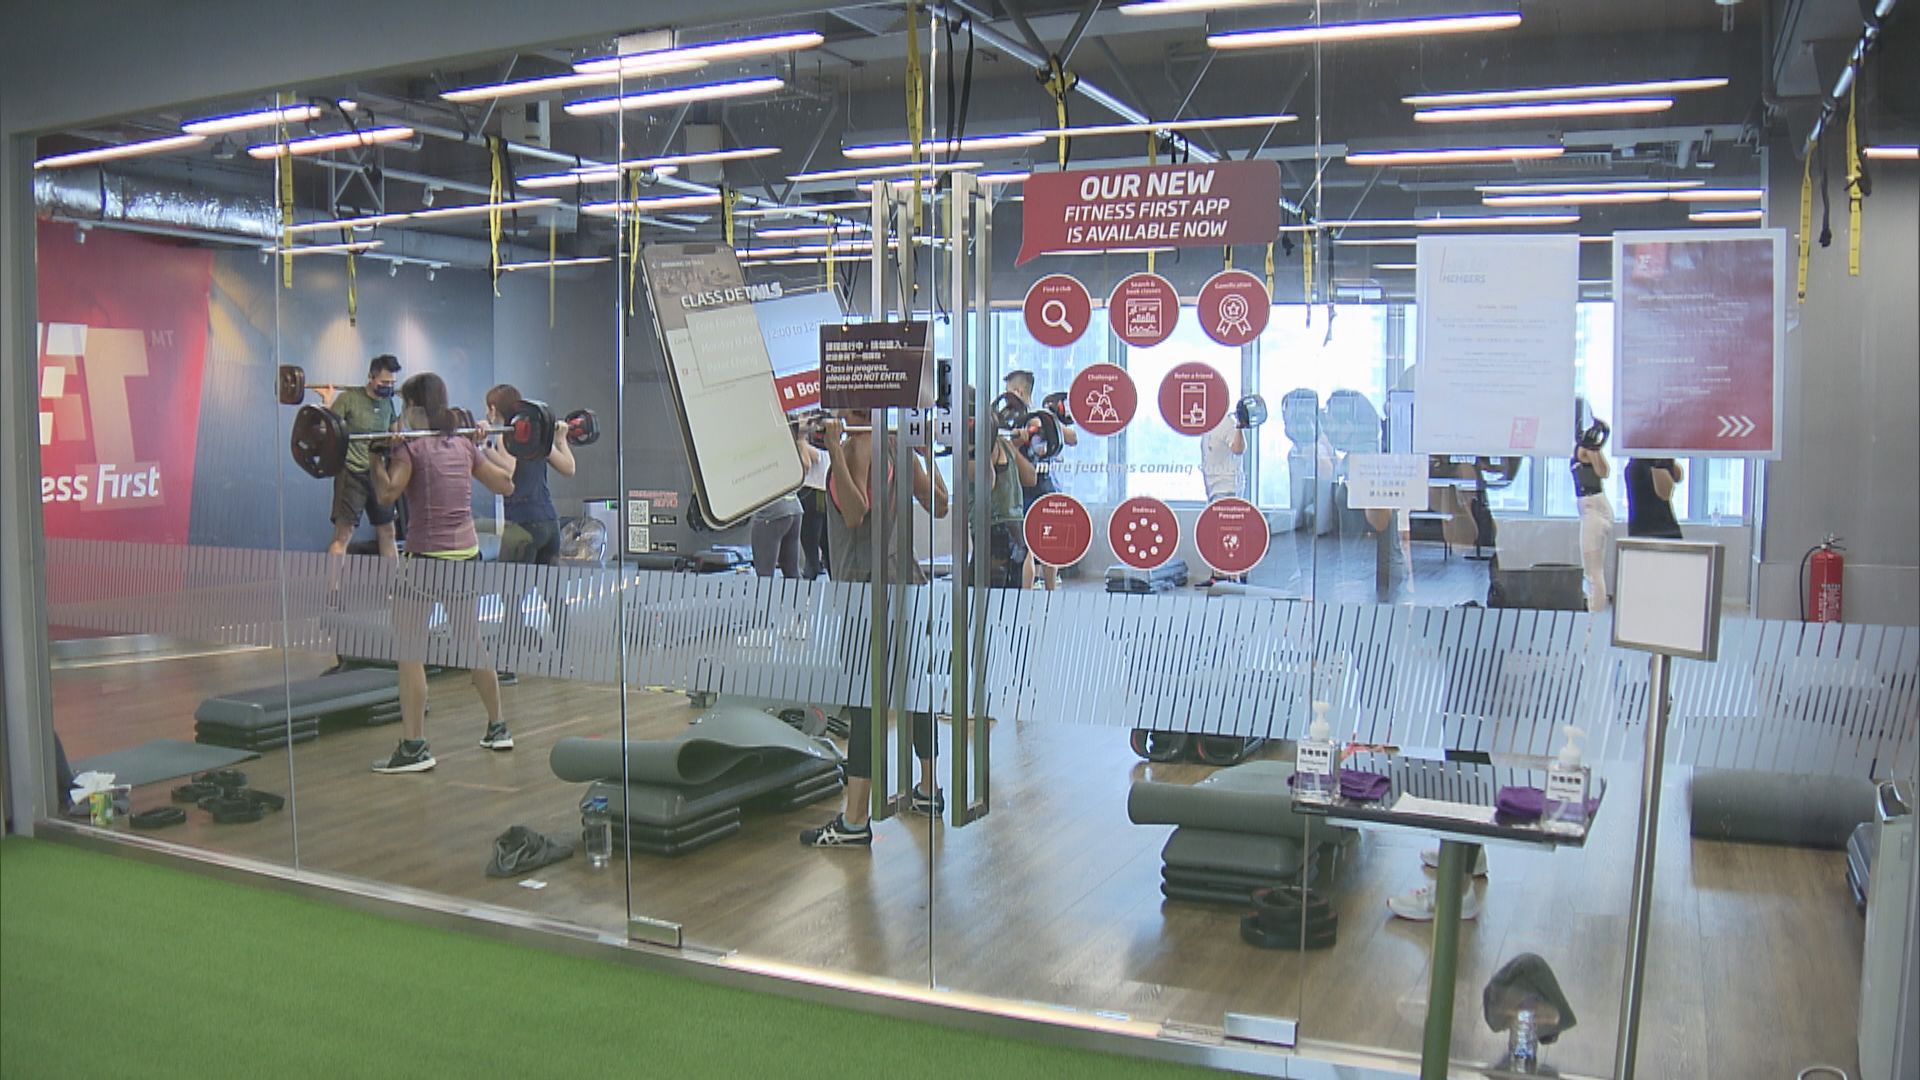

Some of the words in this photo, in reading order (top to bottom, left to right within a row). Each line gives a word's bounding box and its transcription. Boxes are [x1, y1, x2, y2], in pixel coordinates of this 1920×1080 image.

[1080, 175, 1140, 201] OUR
[1146, 170, 1215, 197] NEW
[1065, 201, 1136, 223] FITNESS
[1138, 200, 1190, 218] FIRST
[1192, 198, 1230, 216] APP
[1067, 226, 1083, 243] IS
[1085, 222, 1180, 243] AVAILABLE
[1183, 220, 1229, 238] NOW
[1214, 281, 1252, 289] Gamification
[681, 291, 723, 308] CLASS
[726, 282, 783, 303] DETAILS
[825, 364, 845, 373] Class
[846, 364, 854, 373] in
[825, 373, 851, 383] please
[851, 373, 863, 381] DO
[863, 372, 880, 381] NOT
[1087, 374, 1118, 382] Challenges
[1035, 461, 1072, 474] more
[1073, 459, 1136, 476] features
[1139, 461, 1193, 476] coming
[96, 463, 161, 504] First
[1048, 501, 1068, 509] Digital
[1218, 512, 1245, 520] Passport
